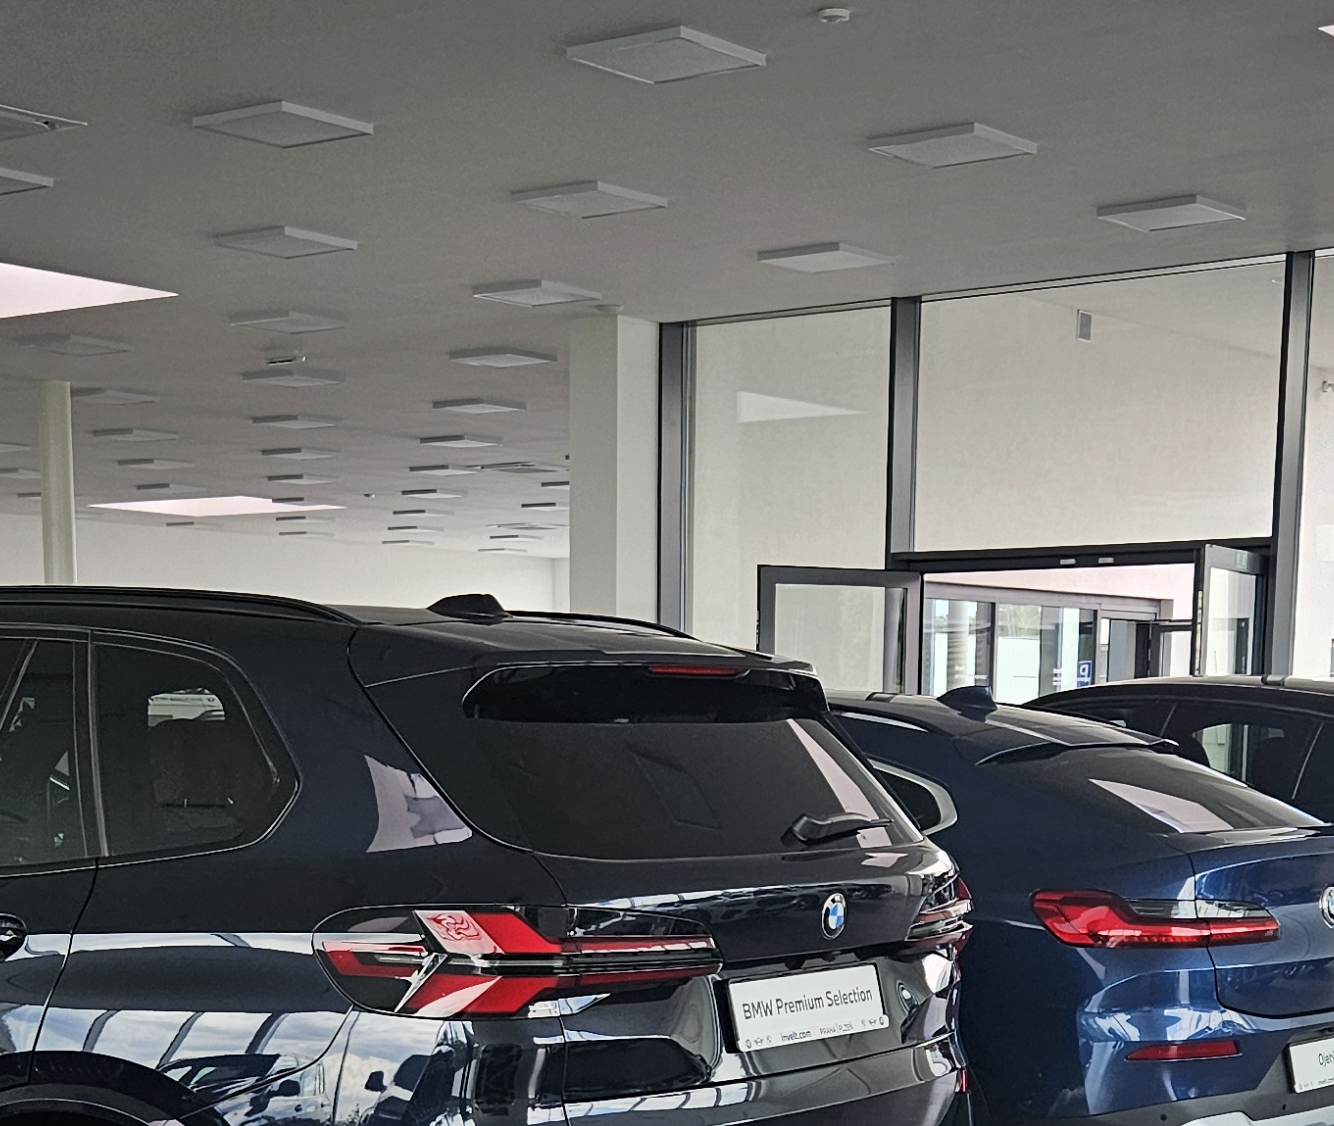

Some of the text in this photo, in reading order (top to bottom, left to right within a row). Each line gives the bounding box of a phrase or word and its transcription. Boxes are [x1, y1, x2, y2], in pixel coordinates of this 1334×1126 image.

[742, 987, 873, 1019] BMW Premium Selection
